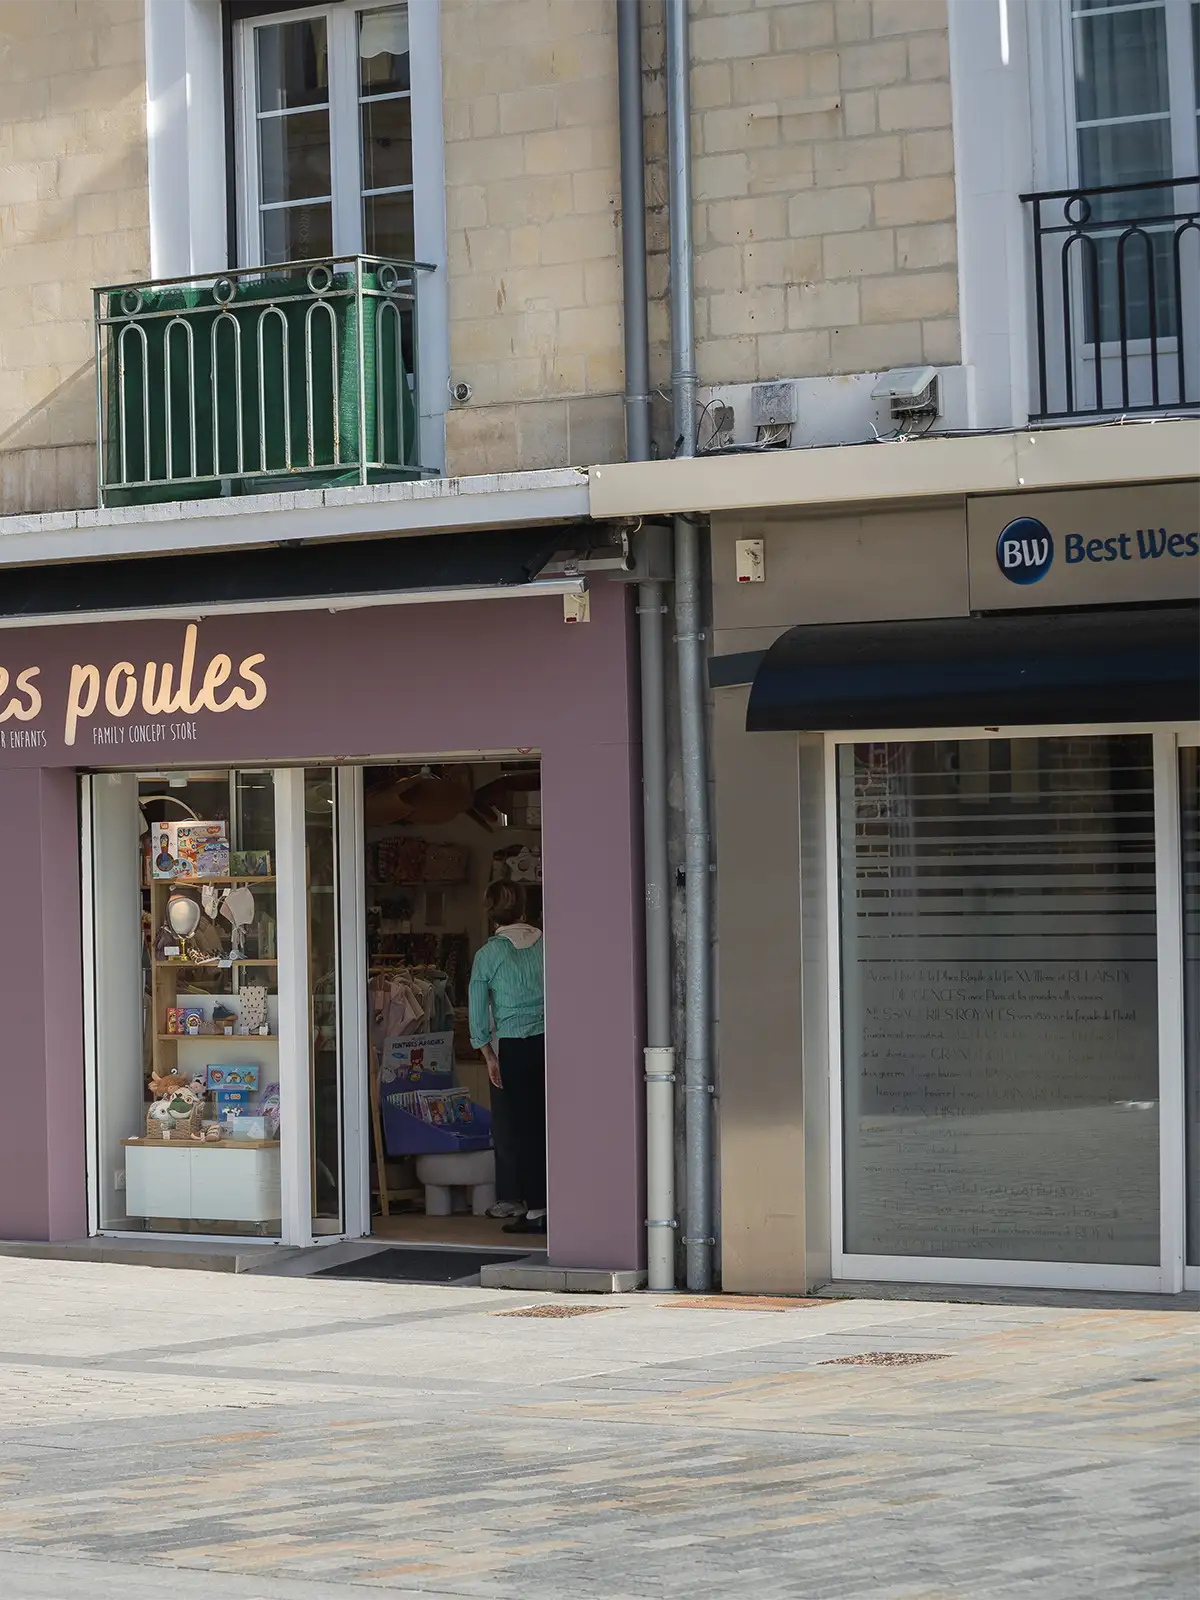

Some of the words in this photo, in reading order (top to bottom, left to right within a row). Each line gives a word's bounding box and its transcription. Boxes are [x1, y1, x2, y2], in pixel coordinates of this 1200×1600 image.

[1003, 537, 1049, 568] BW
[1064, 533, 1132, 564] Best
[1136, 527, 1200, 560] Wes
[63, 622, 269, 747] poules
[10, 729, 48, 749] ENFANTS
[92, 726, 125, 745] FAMILY
[128, 724, 166, 744] CONCEPT
[170, 721, 198, 741] STORE
